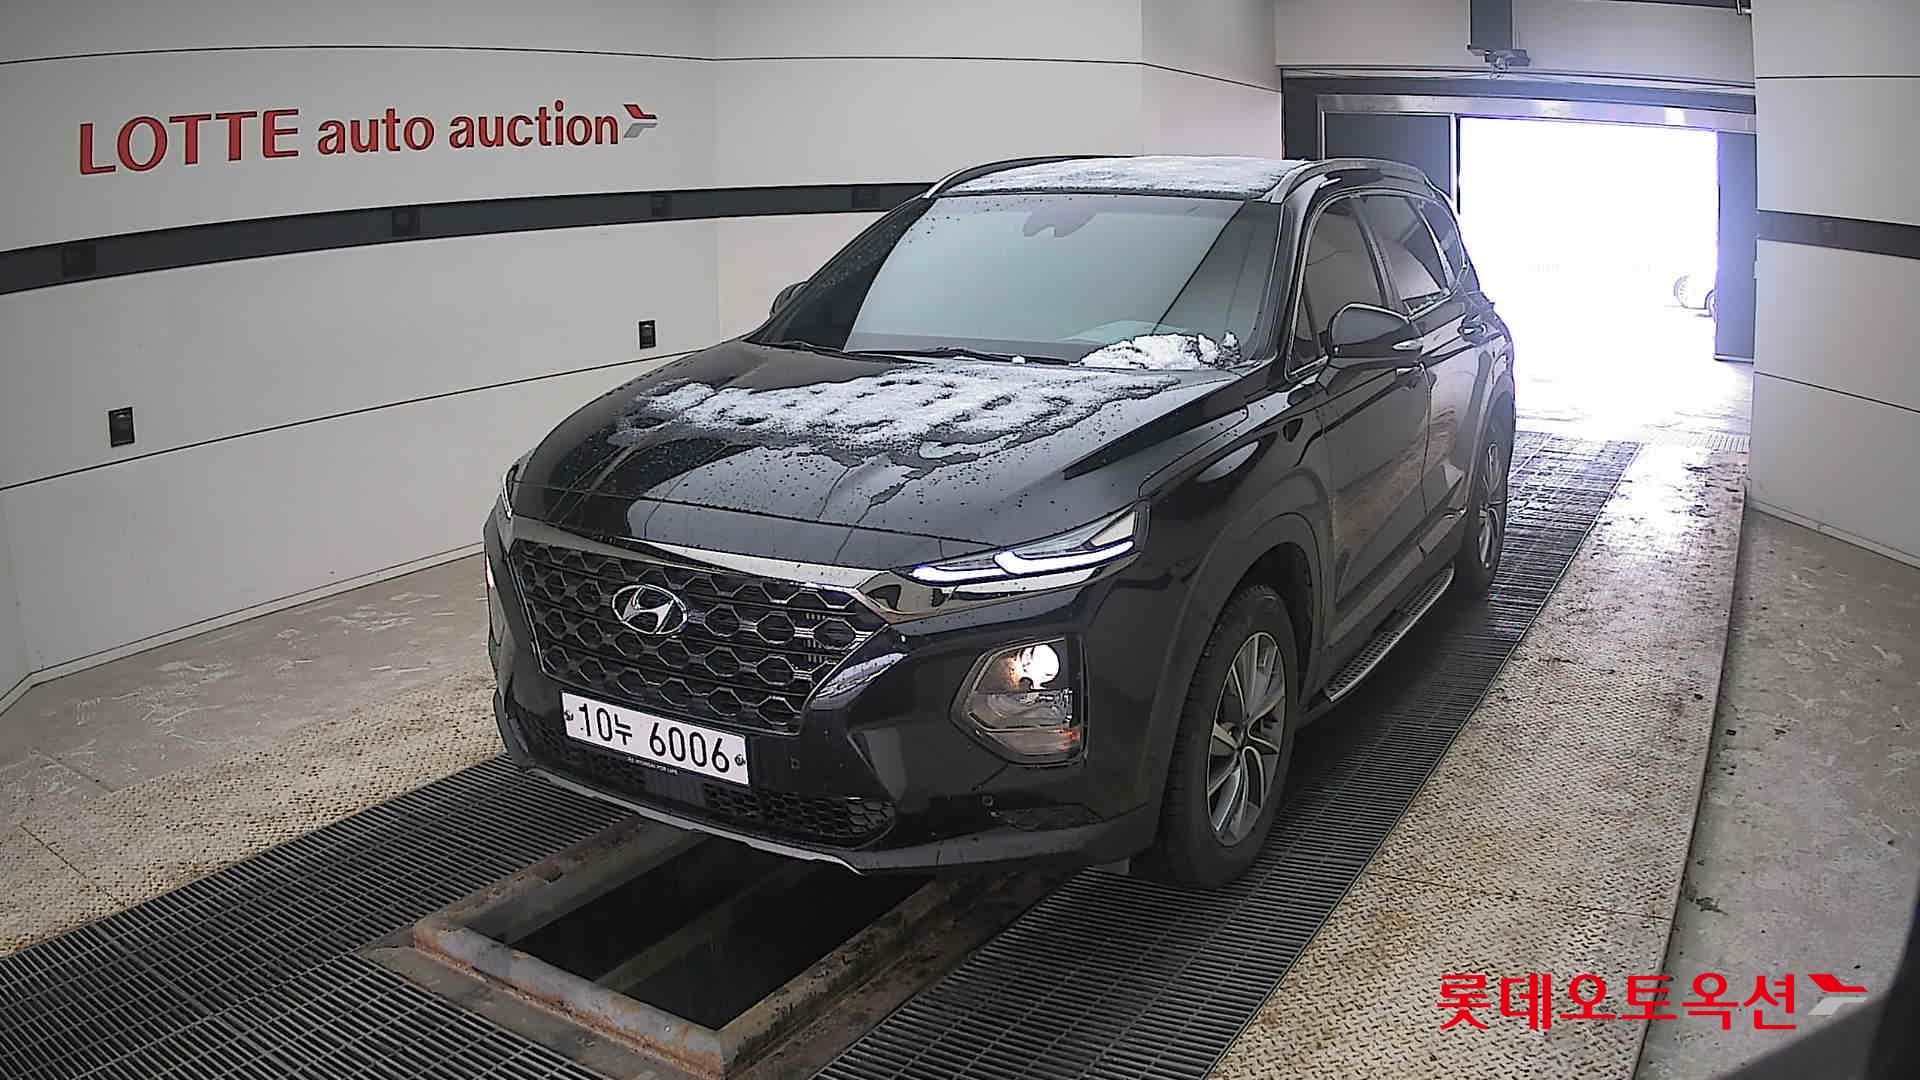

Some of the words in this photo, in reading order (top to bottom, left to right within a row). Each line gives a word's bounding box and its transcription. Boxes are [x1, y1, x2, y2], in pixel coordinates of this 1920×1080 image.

[79, 108, 299, 175] LOTTE
[317, 108, 435, 155] auto
[448, 100, 620, 147] auction
[578, 703, 633, 746] 10누
[649, 722, 730, 773] 6006
